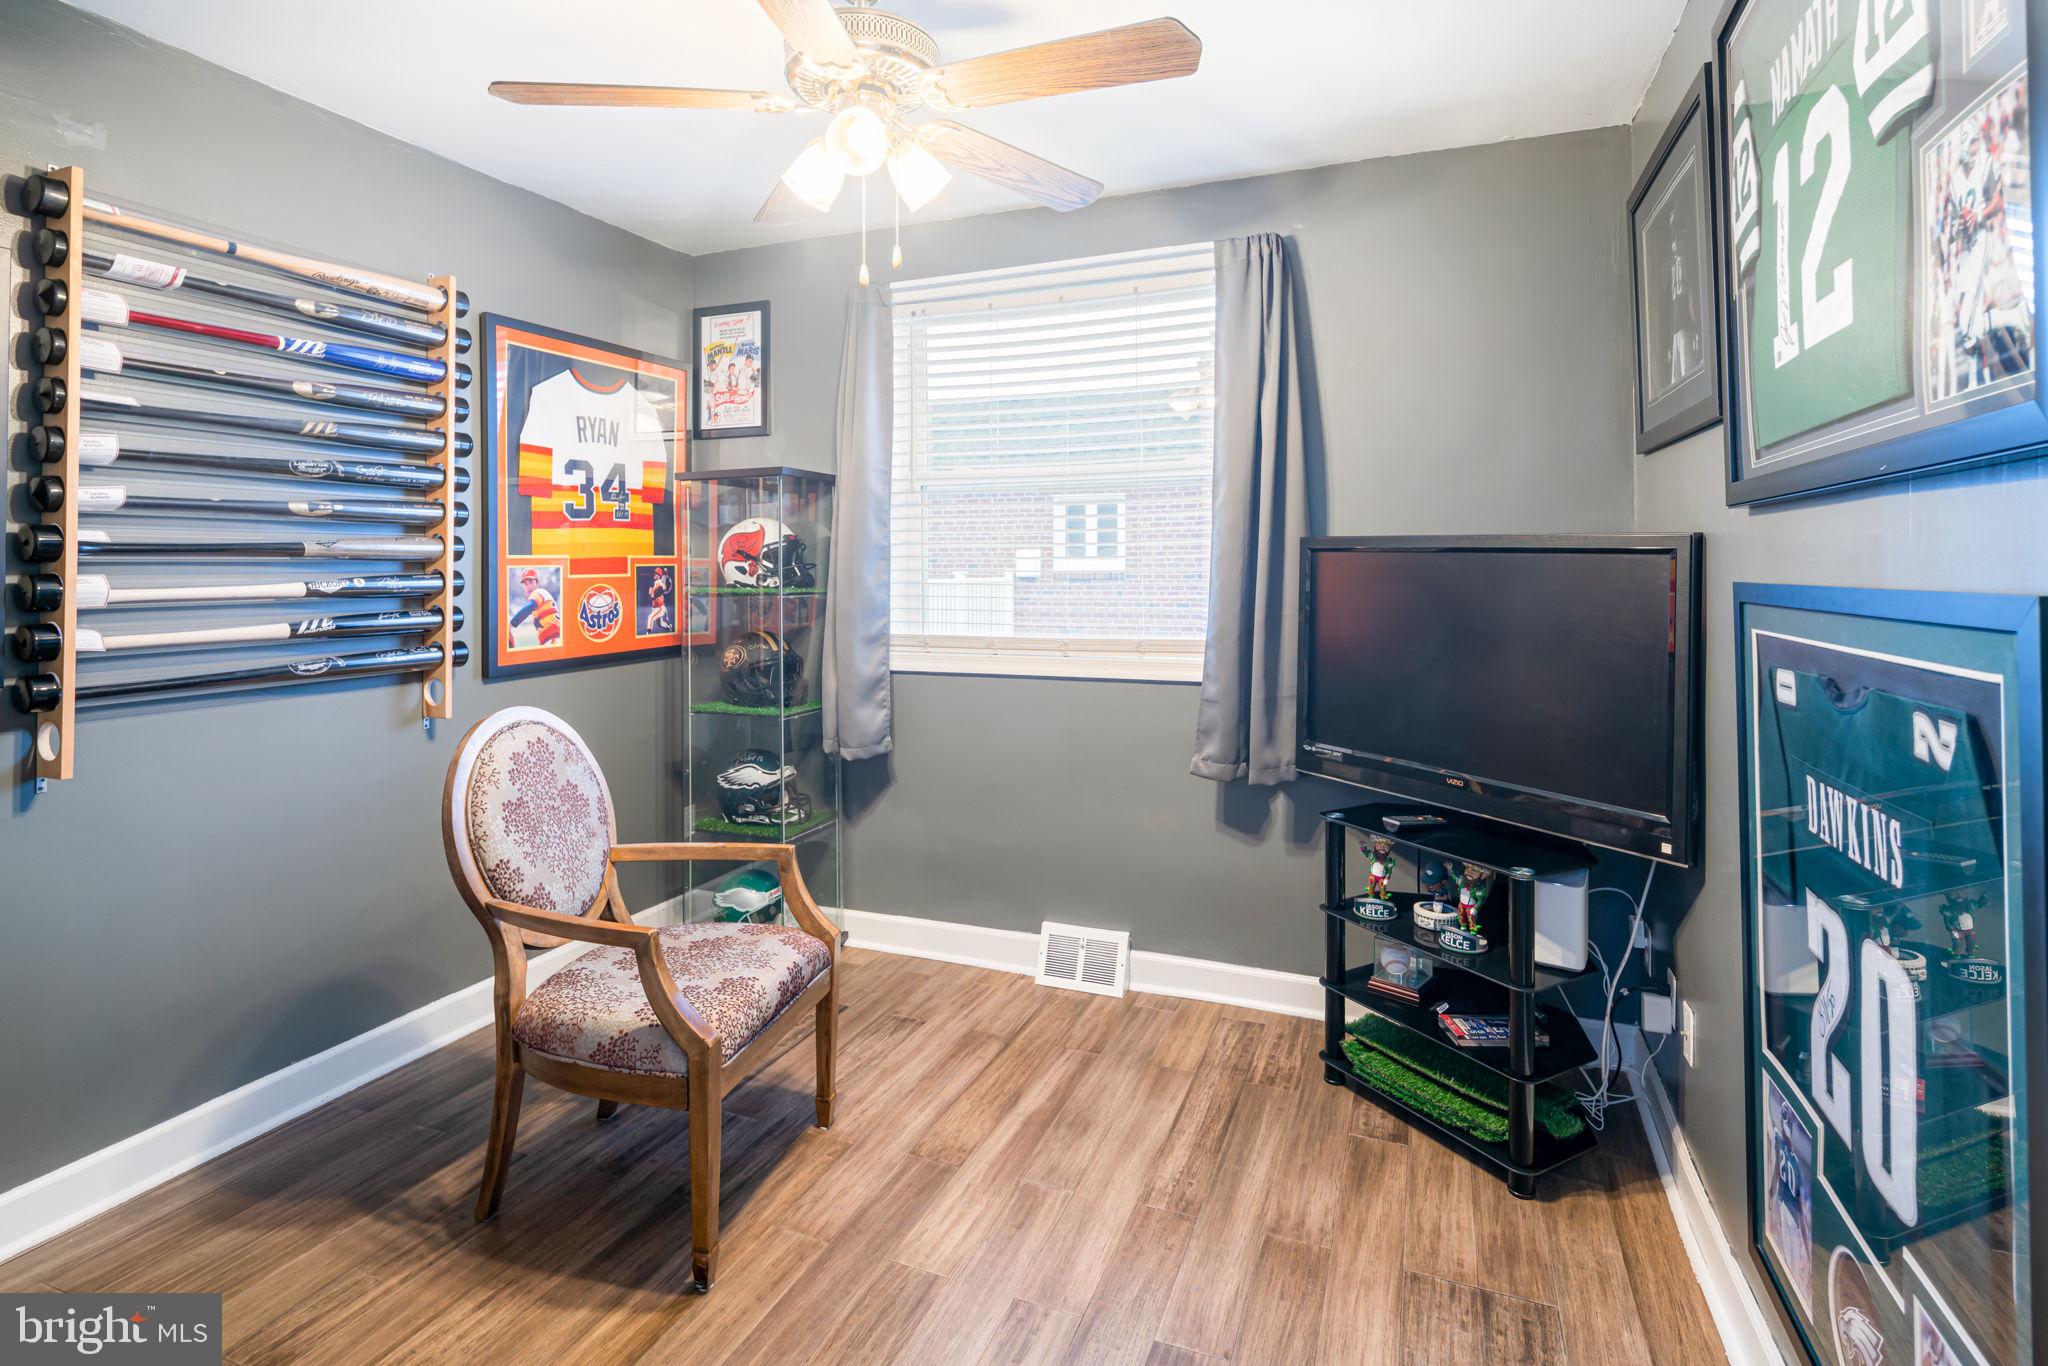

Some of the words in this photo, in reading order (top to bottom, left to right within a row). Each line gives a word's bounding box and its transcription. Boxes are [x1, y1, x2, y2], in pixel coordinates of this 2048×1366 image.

[1770, 0, 1839, 127] NAMATH
[1772, 83, 1854, 370] 12
[312, 271, 359, 288] Rawlings
[576, 415, 620, 447] RYAN
[563, 458, 631, 521] 34
[579, 600, 620, 630] Astros
[1806, 774, 1903, 889] DAWKINS
[1360, 906, 1389, 918] KELCE
[1440, 932, 1470, 950] KELCE
[1445, 931, 1463, 941] JASON
[1805, 886, 1918, 1227] 20
[1779, 1149, 1796, 1198] 20
